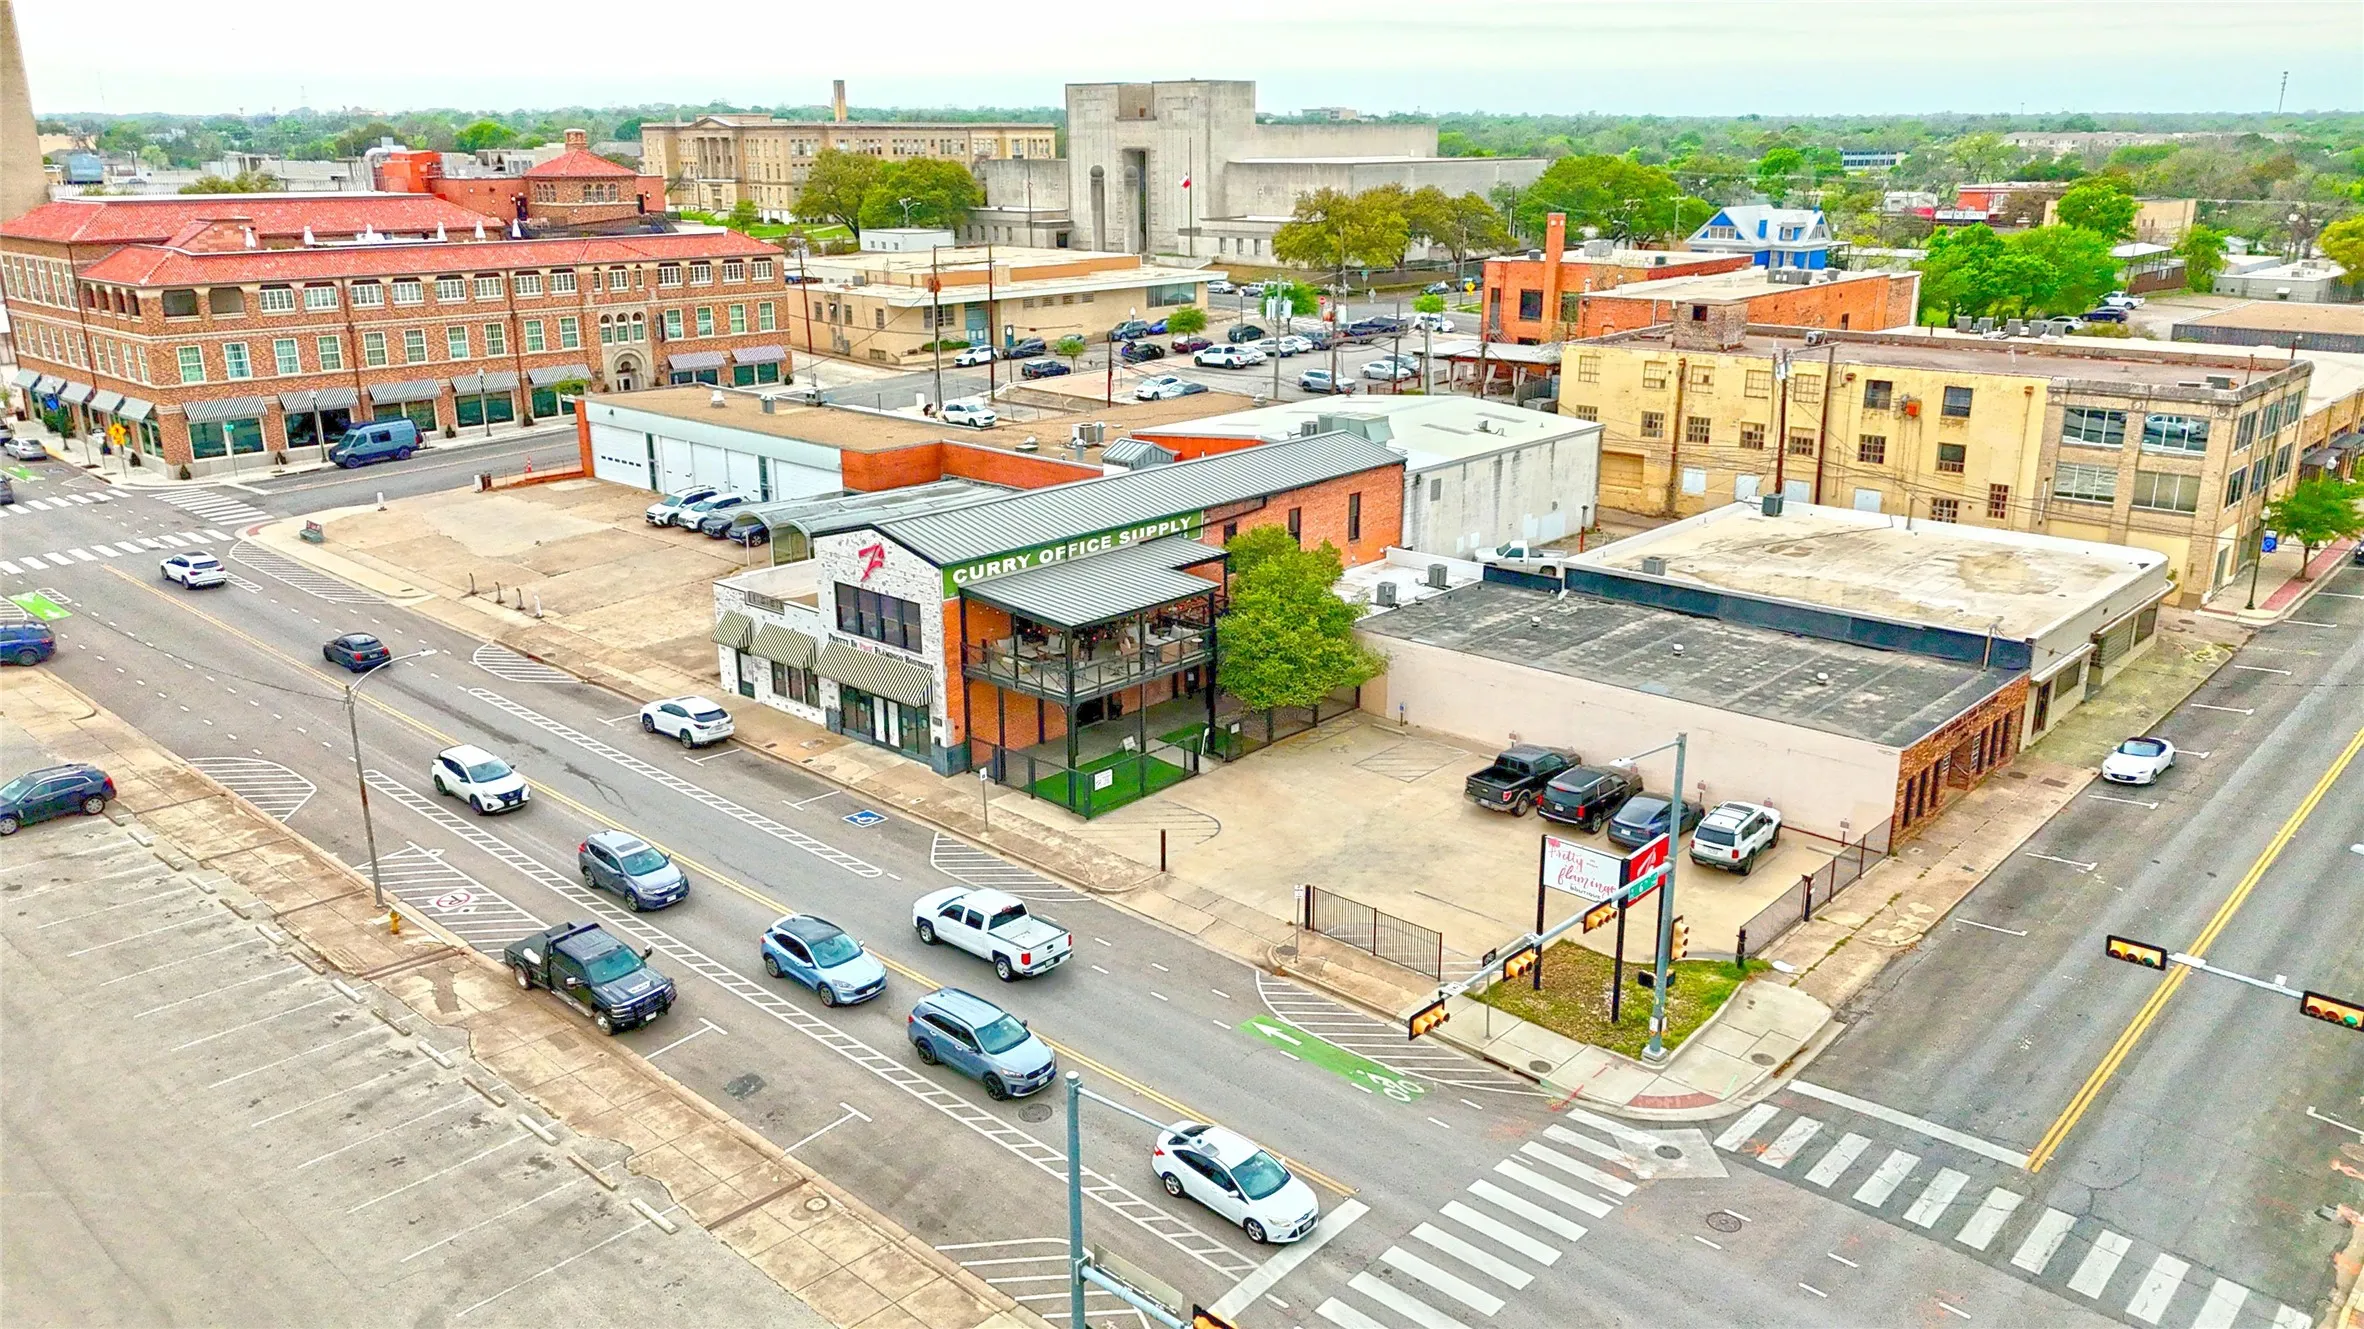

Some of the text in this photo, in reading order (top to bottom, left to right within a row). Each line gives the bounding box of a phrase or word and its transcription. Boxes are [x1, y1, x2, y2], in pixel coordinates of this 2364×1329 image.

[953, 516, 1192, 584] CURRY OFFICE SUPPLY
